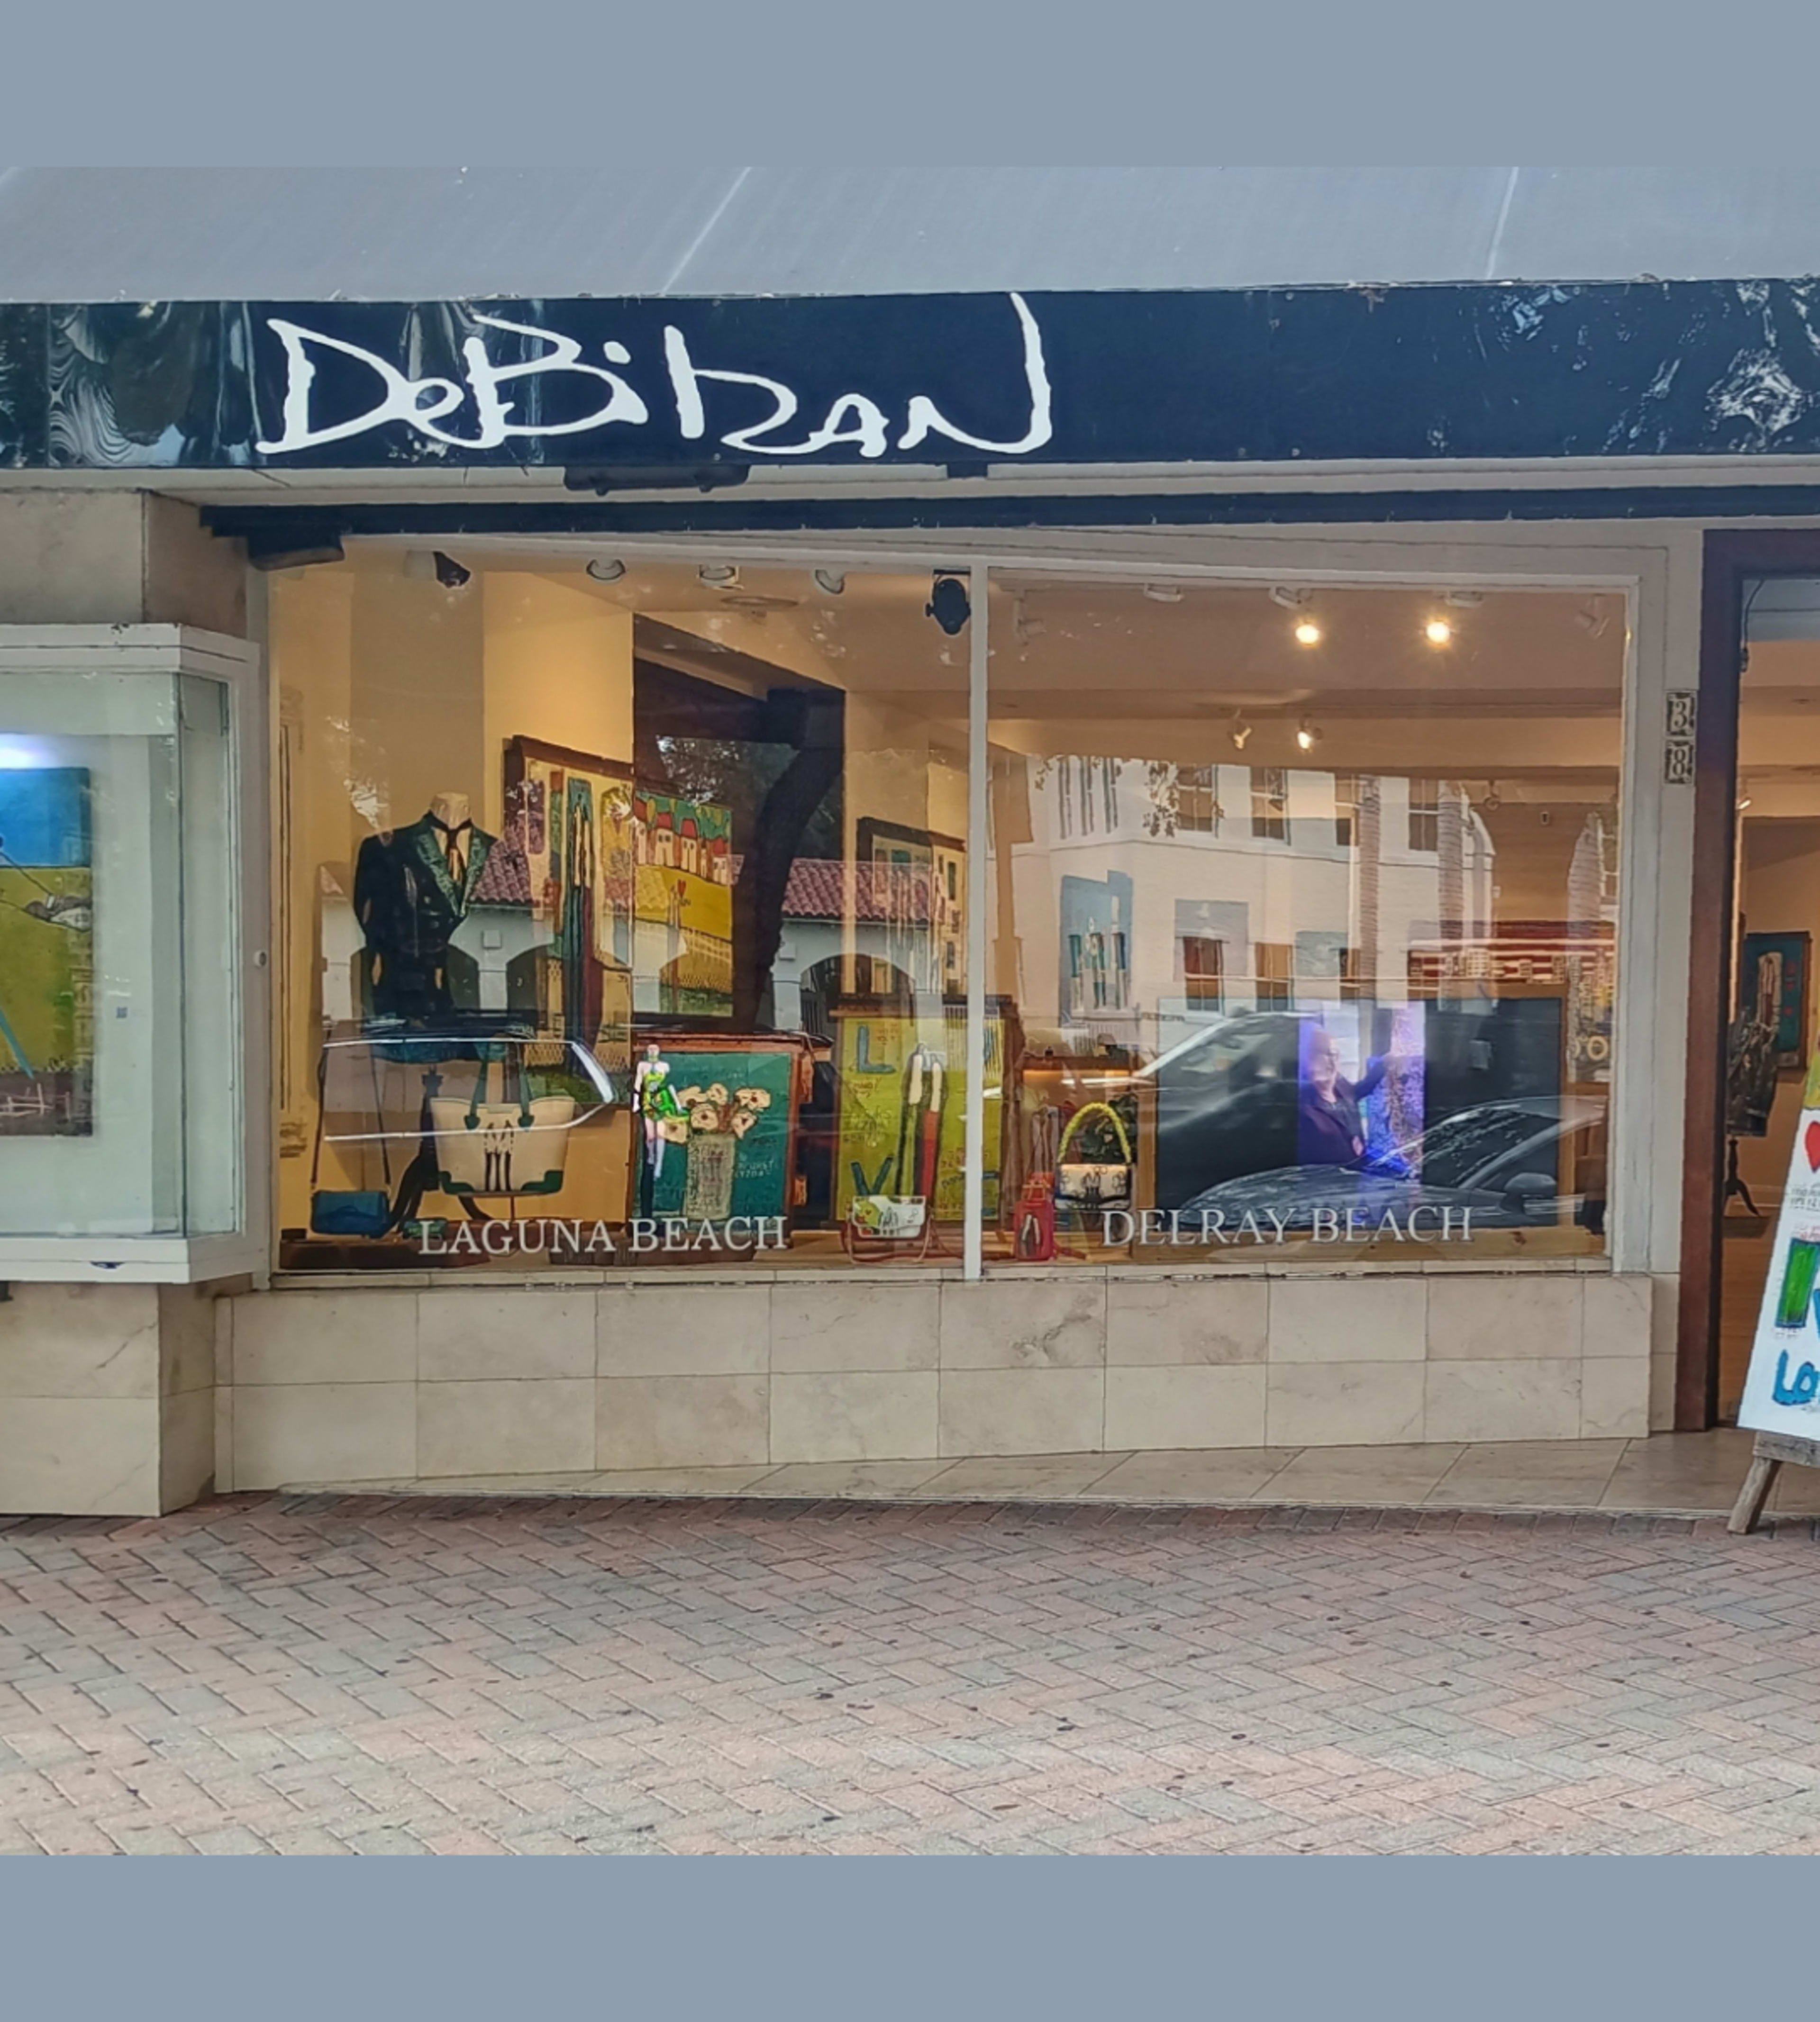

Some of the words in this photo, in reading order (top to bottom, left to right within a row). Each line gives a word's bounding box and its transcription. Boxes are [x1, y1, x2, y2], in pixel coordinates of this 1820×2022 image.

[419, 1218, 616, 1255] LAGUNA
[628, 1216, 789, 1252] BEACH
[1102, 1207, 1297, 1246] DELRAY
[1310, 1205, 1474, 1244] BEACH
